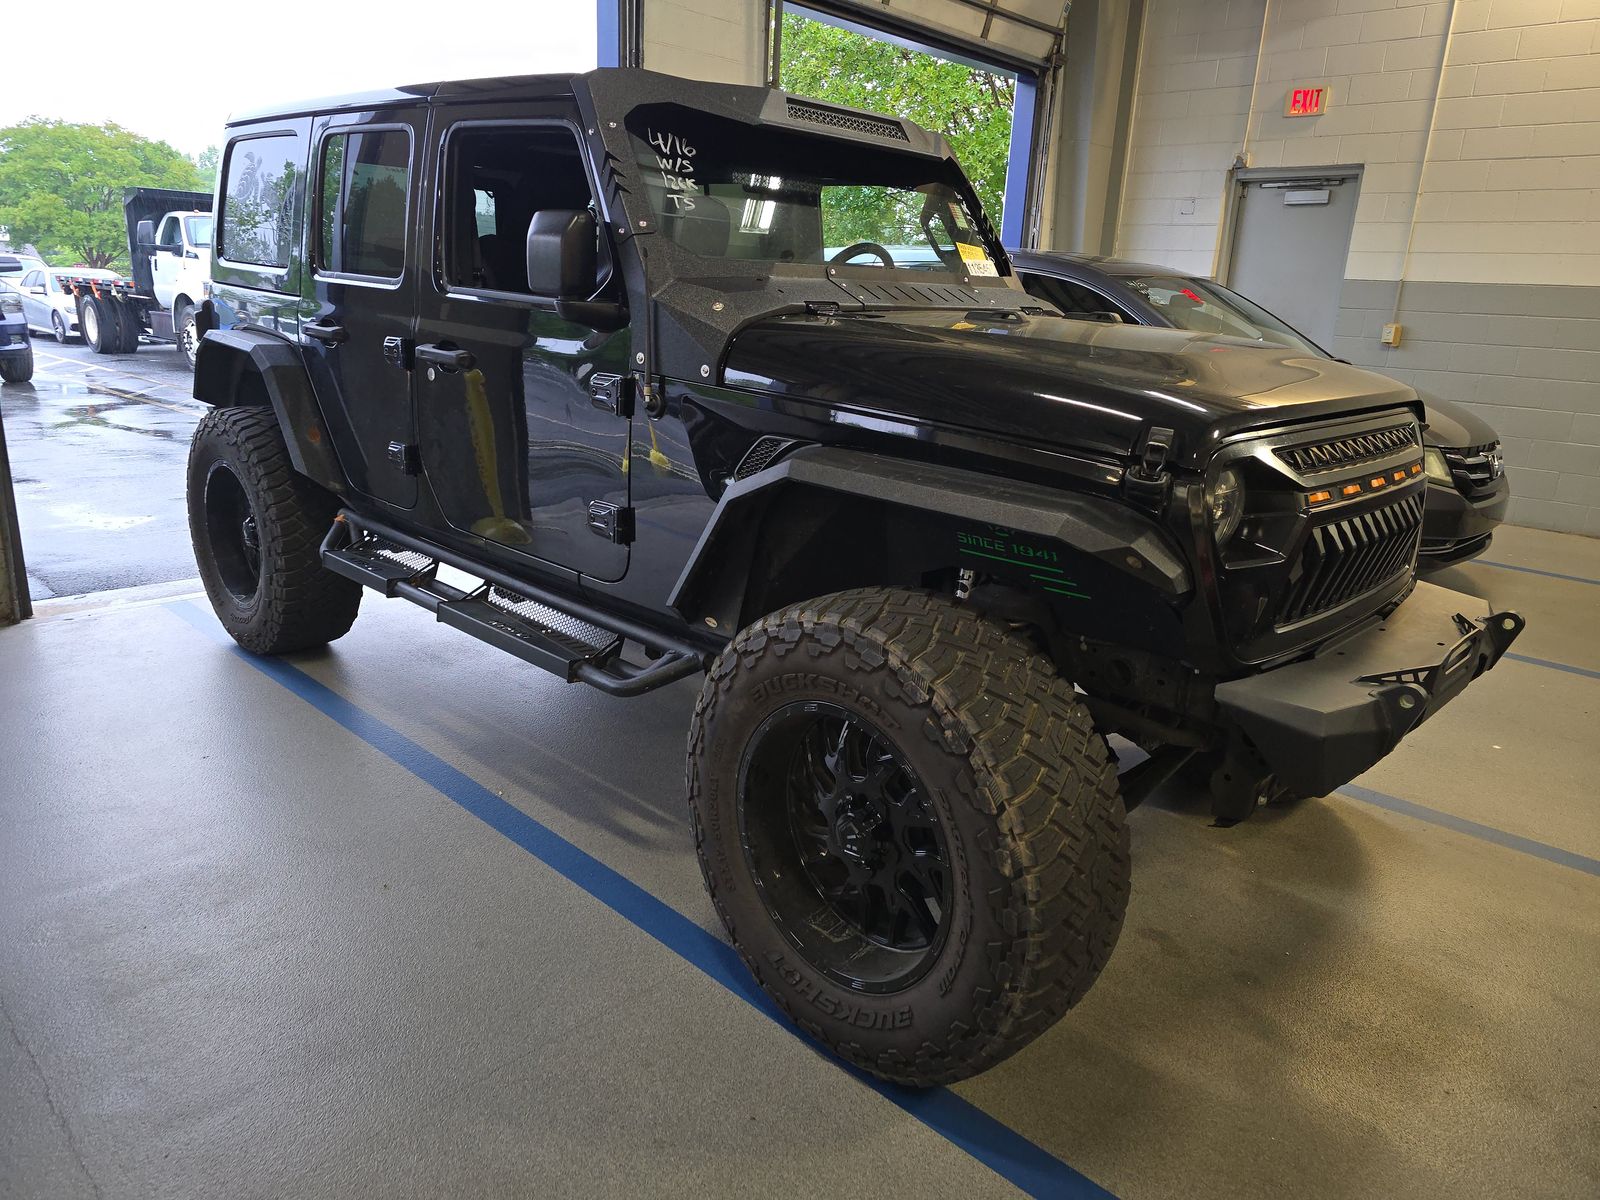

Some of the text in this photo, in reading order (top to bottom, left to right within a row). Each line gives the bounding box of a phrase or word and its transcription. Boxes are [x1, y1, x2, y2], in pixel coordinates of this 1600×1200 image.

[1290, 88, 1323, 114] EXIT
[647, 127, 697, 158] 4/16
[666, 194, 696, 211] TS
[1011, 543, 1058, 562] 1941
[751, 672, 903, 730] BUCKSHOT
[766, 952, 915, 1031] BUCKSHOT
